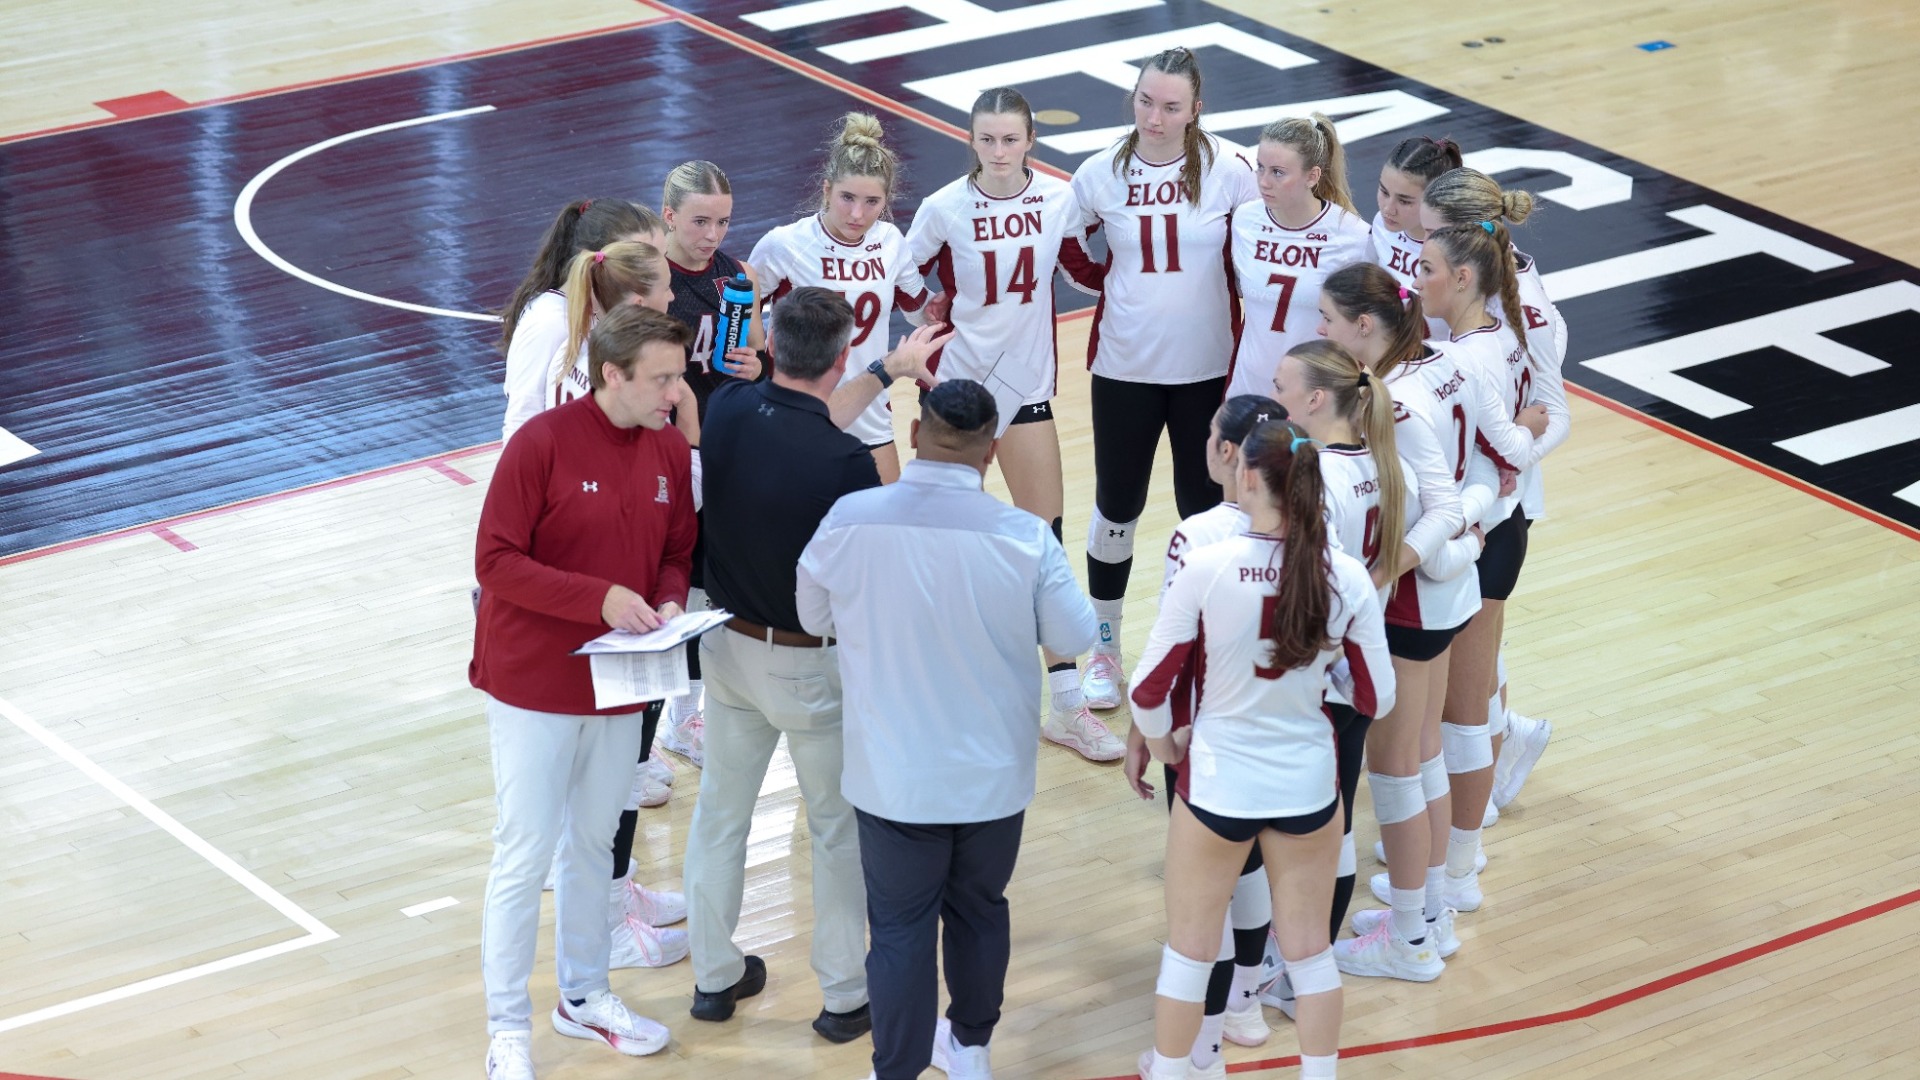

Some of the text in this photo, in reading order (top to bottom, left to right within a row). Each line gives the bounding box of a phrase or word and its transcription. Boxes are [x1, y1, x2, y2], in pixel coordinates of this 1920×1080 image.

[1022, 195, 1044, 205] CAA
[971, 210, 1043, 242] ELON
[1136, 213, 1184, 273] 11
[1305, 232, 1328, 242] CAA
[820, 256, 886, 281] ELON
[1254, 239, 1323, 269] ELON
[979, 245, 1040, 307] 14
[834, 290, 882, 348] 9
[1266, 272, 1298, 334] 7
[689, 314, 713, 374] 4
[727, 303, 742, 355] POWERAD
[1239, 567, 1283, 583] PHO
